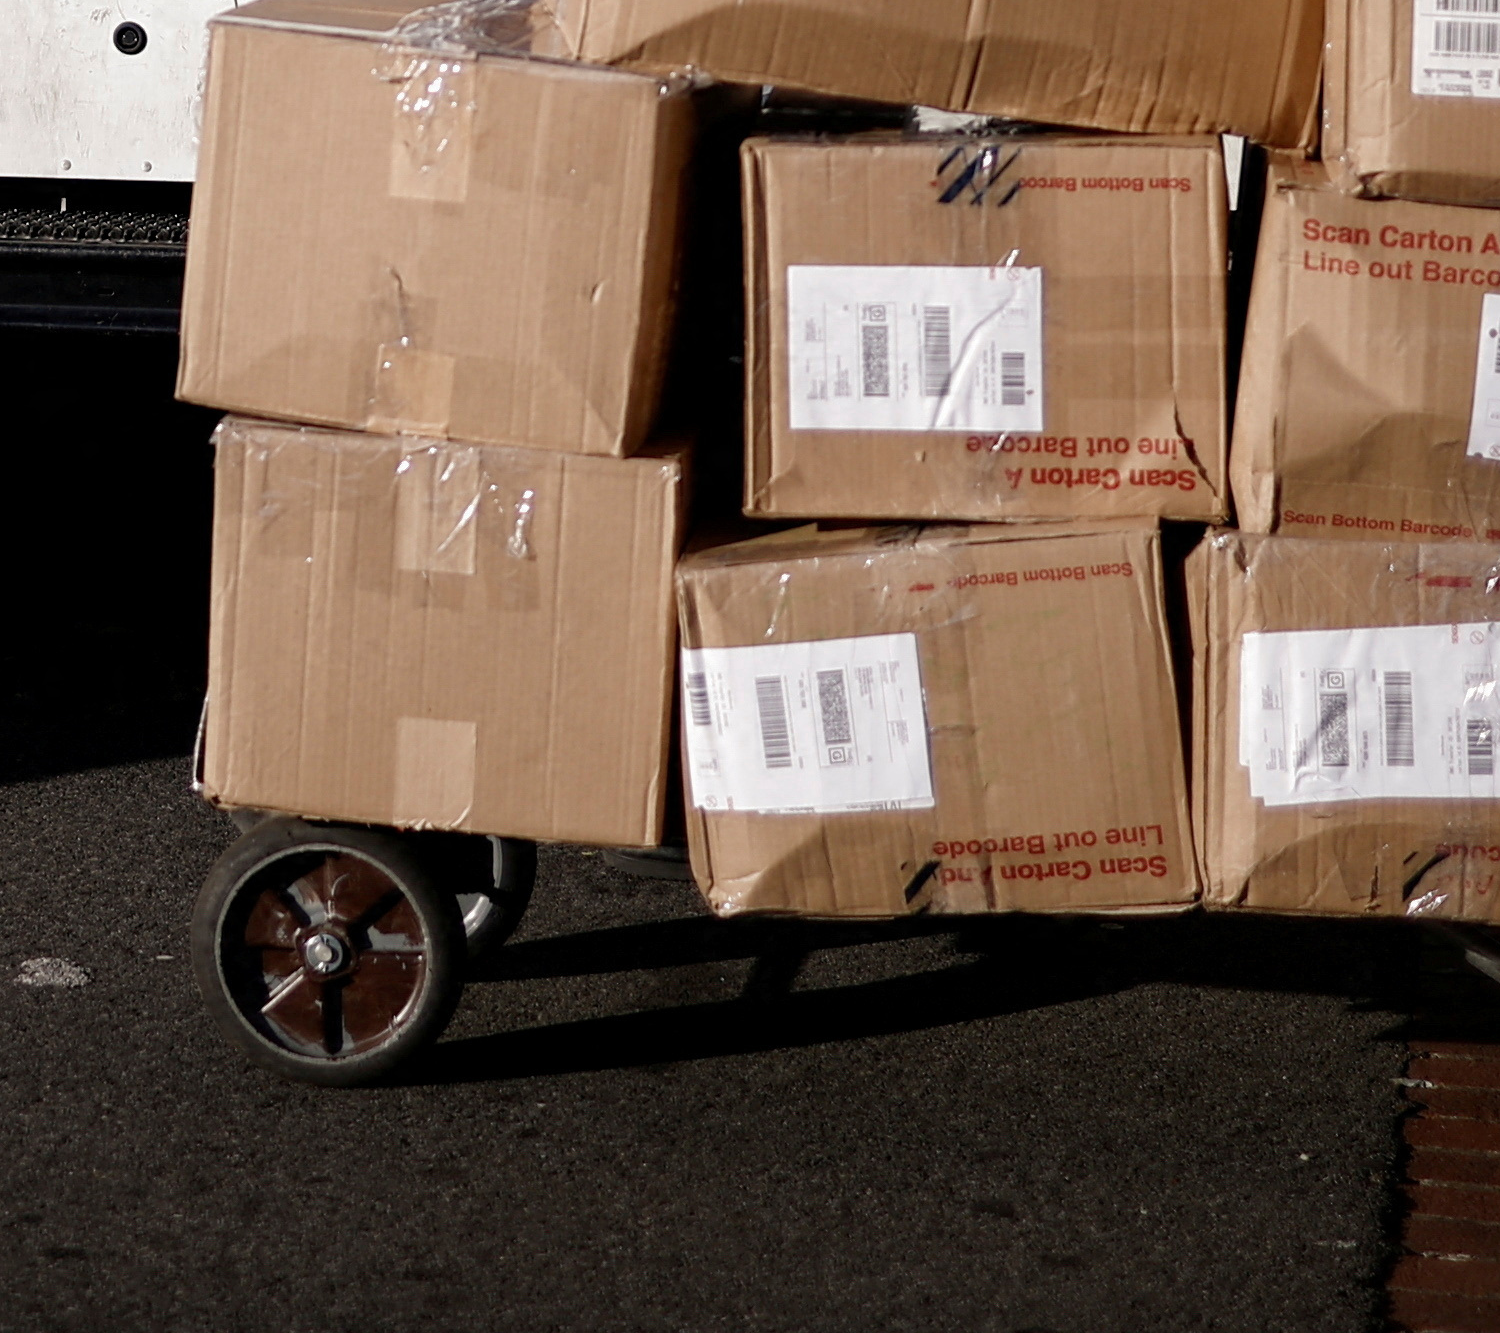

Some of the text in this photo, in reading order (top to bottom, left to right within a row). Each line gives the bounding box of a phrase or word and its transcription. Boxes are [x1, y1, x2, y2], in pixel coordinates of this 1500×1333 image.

[1081, 177, 1144, 192] Bottom
[1149, 177, 1192, 192] Scan
[1303, 217, 1371, 245] Scan
[1379, 225, 1473, 253] Carton
[1303, 251, 1360, 276] Line
[1368, 260, 1413, 280] out
[1086, 436, 1131, 456] out
[1138, 437, 1192, 460] ine
[1030, 467, 1120, 490] Carton
[1129, 469, 1196, 491] Scan
[1283, 509, 1473, 538] Scan Bottom Barcode
[1023, 565, 1086, 581] Bottom
[1090, 561, 1133, 577] Scan
[933, 824, 1163, 858] Line out Barcode
[1000, 860, 1092, 882] Carton
[1099, 855, 1167, 878] Scan
